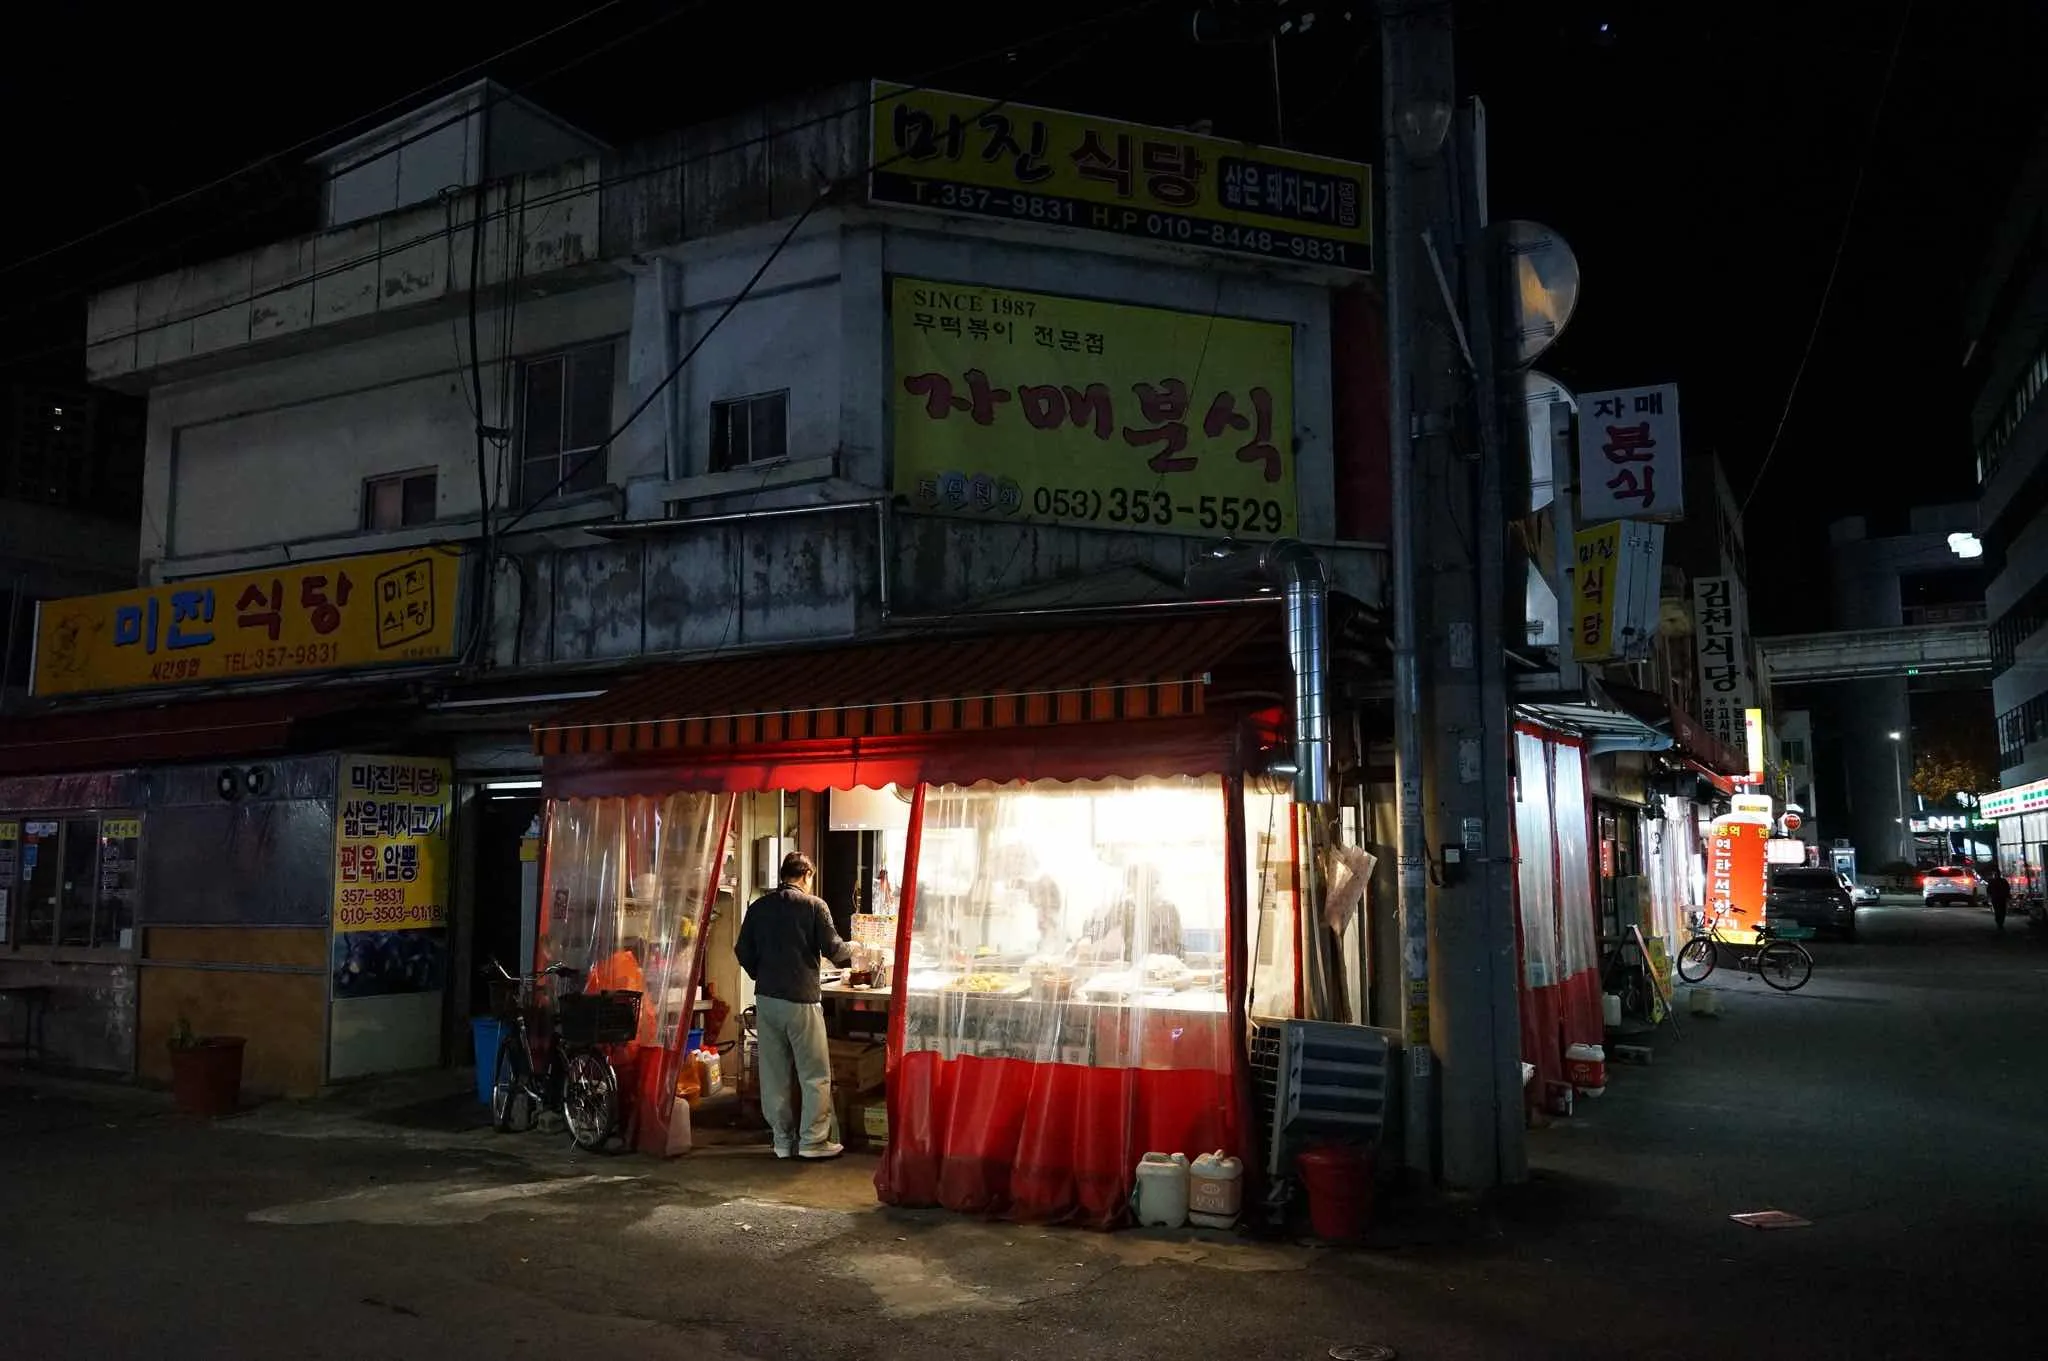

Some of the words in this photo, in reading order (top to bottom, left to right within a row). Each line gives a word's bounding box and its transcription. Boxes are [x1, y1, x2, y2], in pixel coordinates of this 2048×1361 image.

[894, 104, 1055, 182] 미진
[1069, 130, 1206, 207] 식당
[1146, 213, 1347, 264] 010-8448-9831
[913, 289, 983, 312] SINCE
[991, 298, 1036, 319] 1987
[913, 312, 1013, 344] 무떡볶이
[1034, 325, 1104, 355] 전문점
[1594, 392, 1663, 418] 자매
[1603, 422, 1656, 508] 분식
[383, 571, 425, 602] 미진
[383, 601, 429, 632] 식당
[1583, 567, 1604, 646] 식당
[1701, 581, 1740, 692] 김천식당
[352, 765, 441, 795] 미진식당
[343, 800, 448, 839] 삶은돼지고기
[1928, 815, 1967, 829] NH
[341, 888, 405, 904] 357-9831
